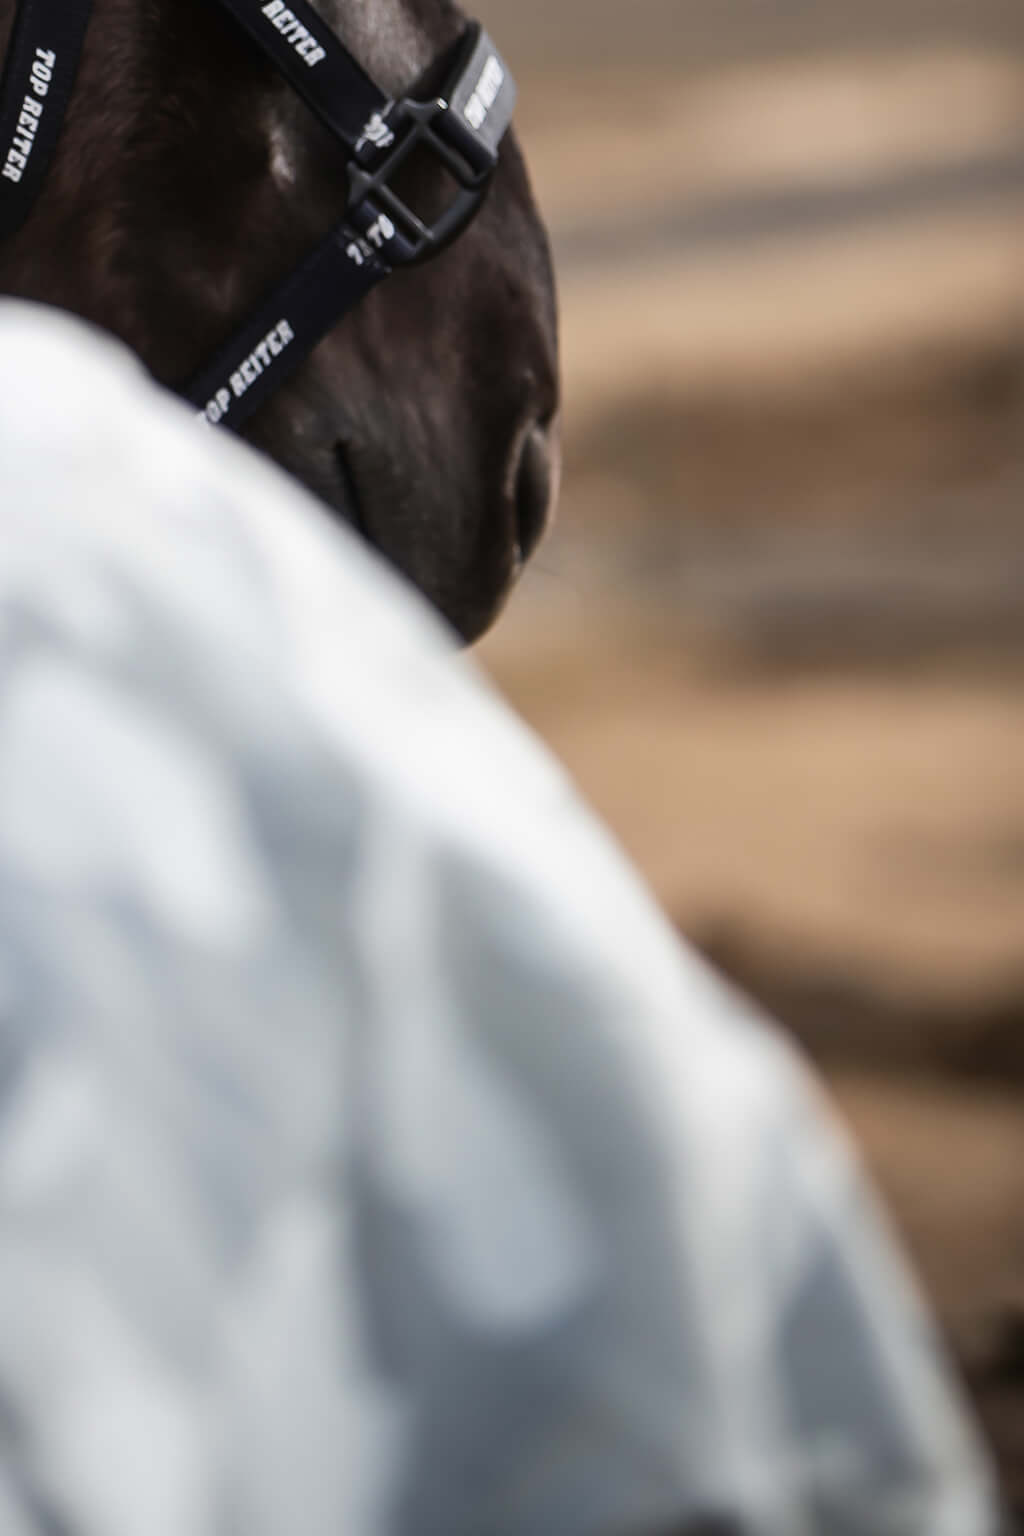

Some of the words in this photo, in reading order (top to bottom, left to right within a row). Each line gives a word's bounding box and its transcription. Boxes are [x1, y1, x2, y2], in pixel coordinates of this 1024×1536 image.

[30, 48, 56, 96] TOP
[2, 95, 43, 183] REITER
[229, 318, 295, 398] REITER
